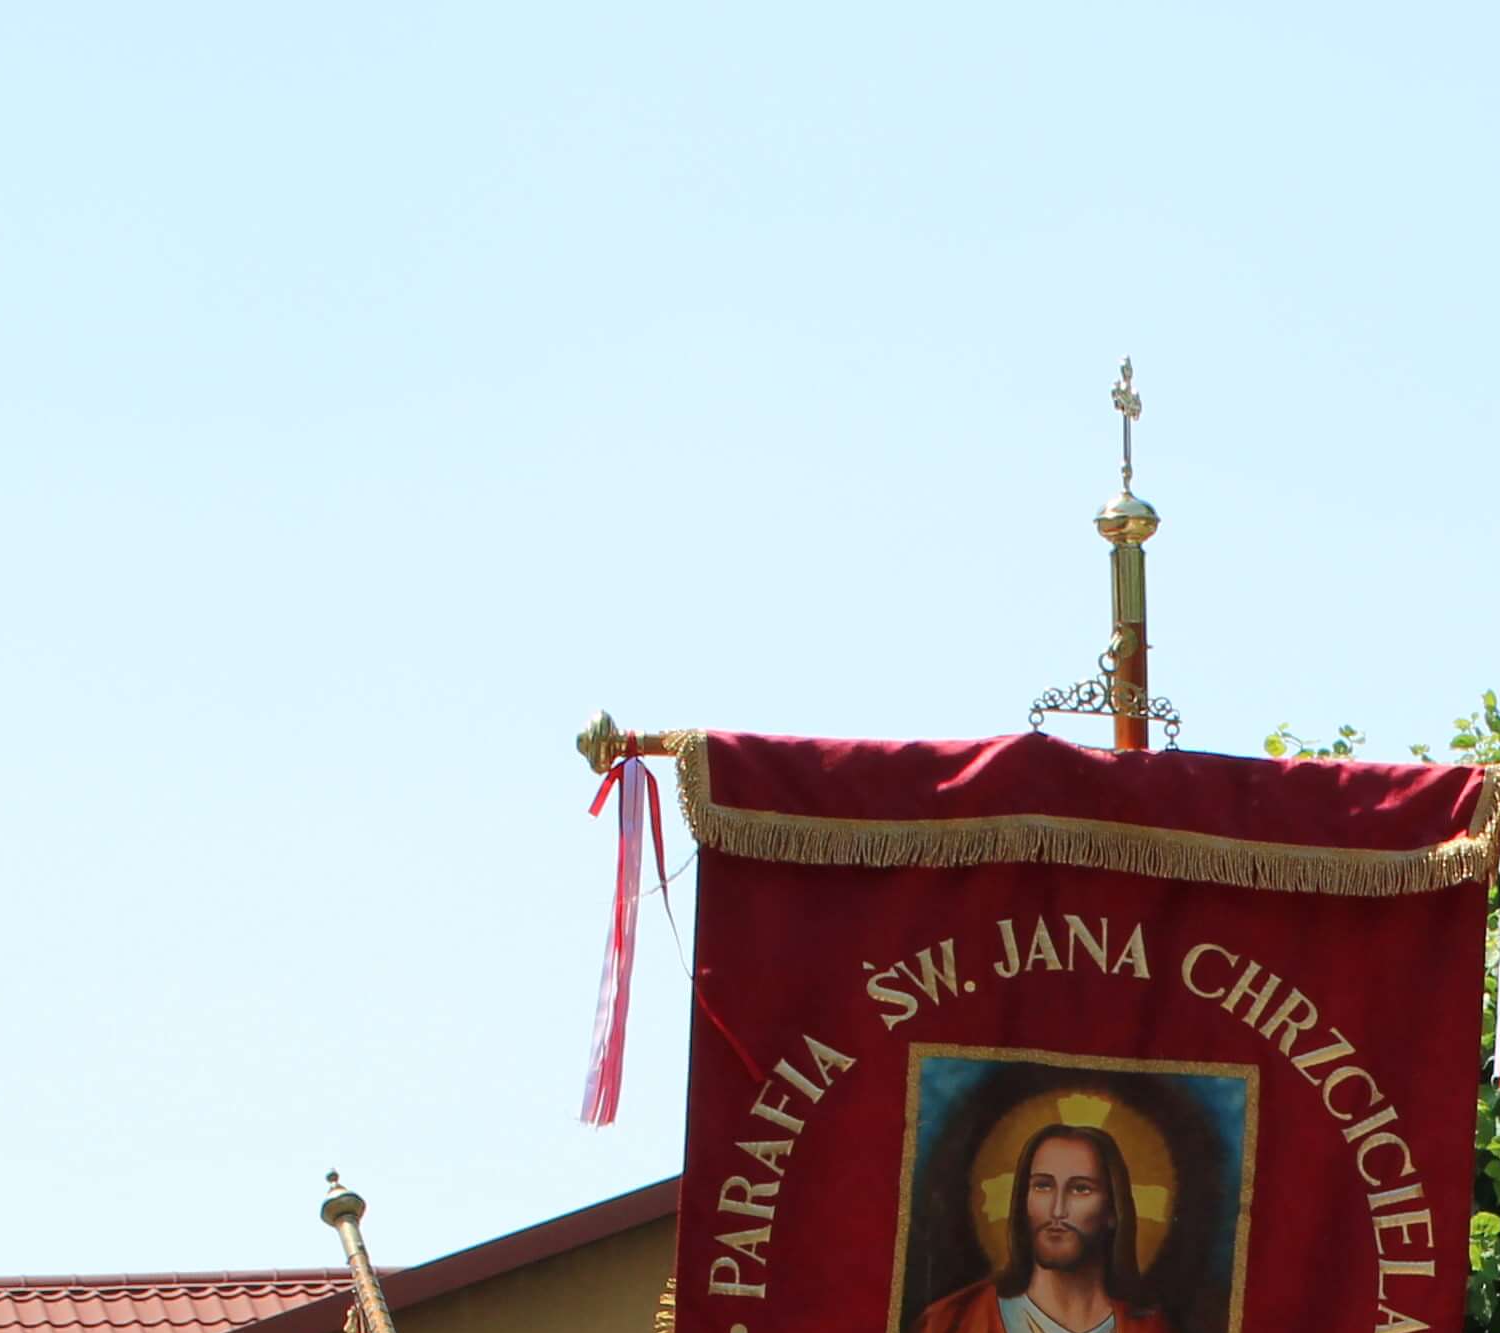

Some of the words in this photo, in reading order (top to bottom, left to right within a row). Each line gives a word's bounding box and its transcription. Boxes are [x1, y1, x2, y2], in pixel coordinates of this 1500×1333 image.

[707, 1033, 858, 1299] PARAFIA
[862, 937, 977, 1032] ŚW.
[993, 913, 1151, 980] JANA
